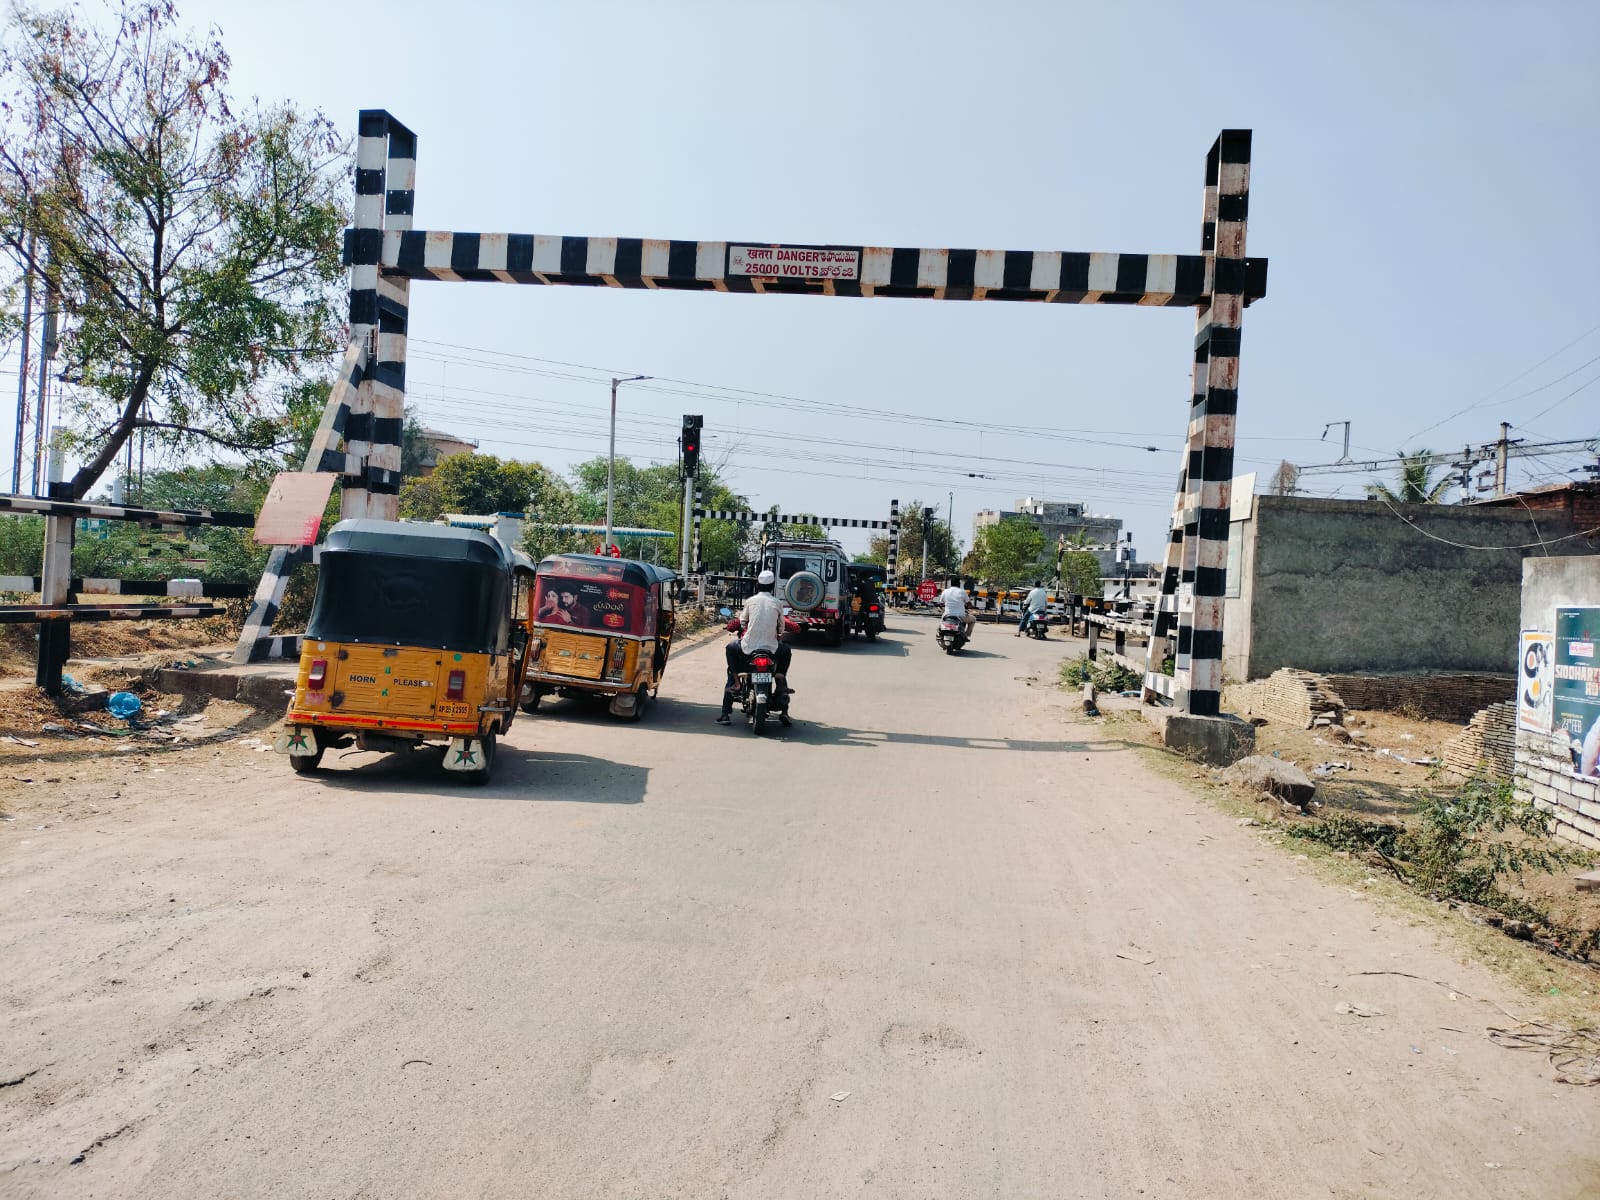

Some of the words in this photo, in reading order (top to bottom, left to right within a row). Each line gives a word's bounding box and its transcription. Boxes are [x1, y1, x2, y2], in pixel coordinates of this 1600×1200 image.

[747, 249, 773, 260] खतरा
[777, 250, 819, 262] DANGER
[745, 263, 779, 275] 25000
[783, 265, 818, 277] VOLTS
[349, 675, 376, 684] HORN
[393, 678, 424, 688] PLEASE
[1572, 719, 1583, 733] FEB
